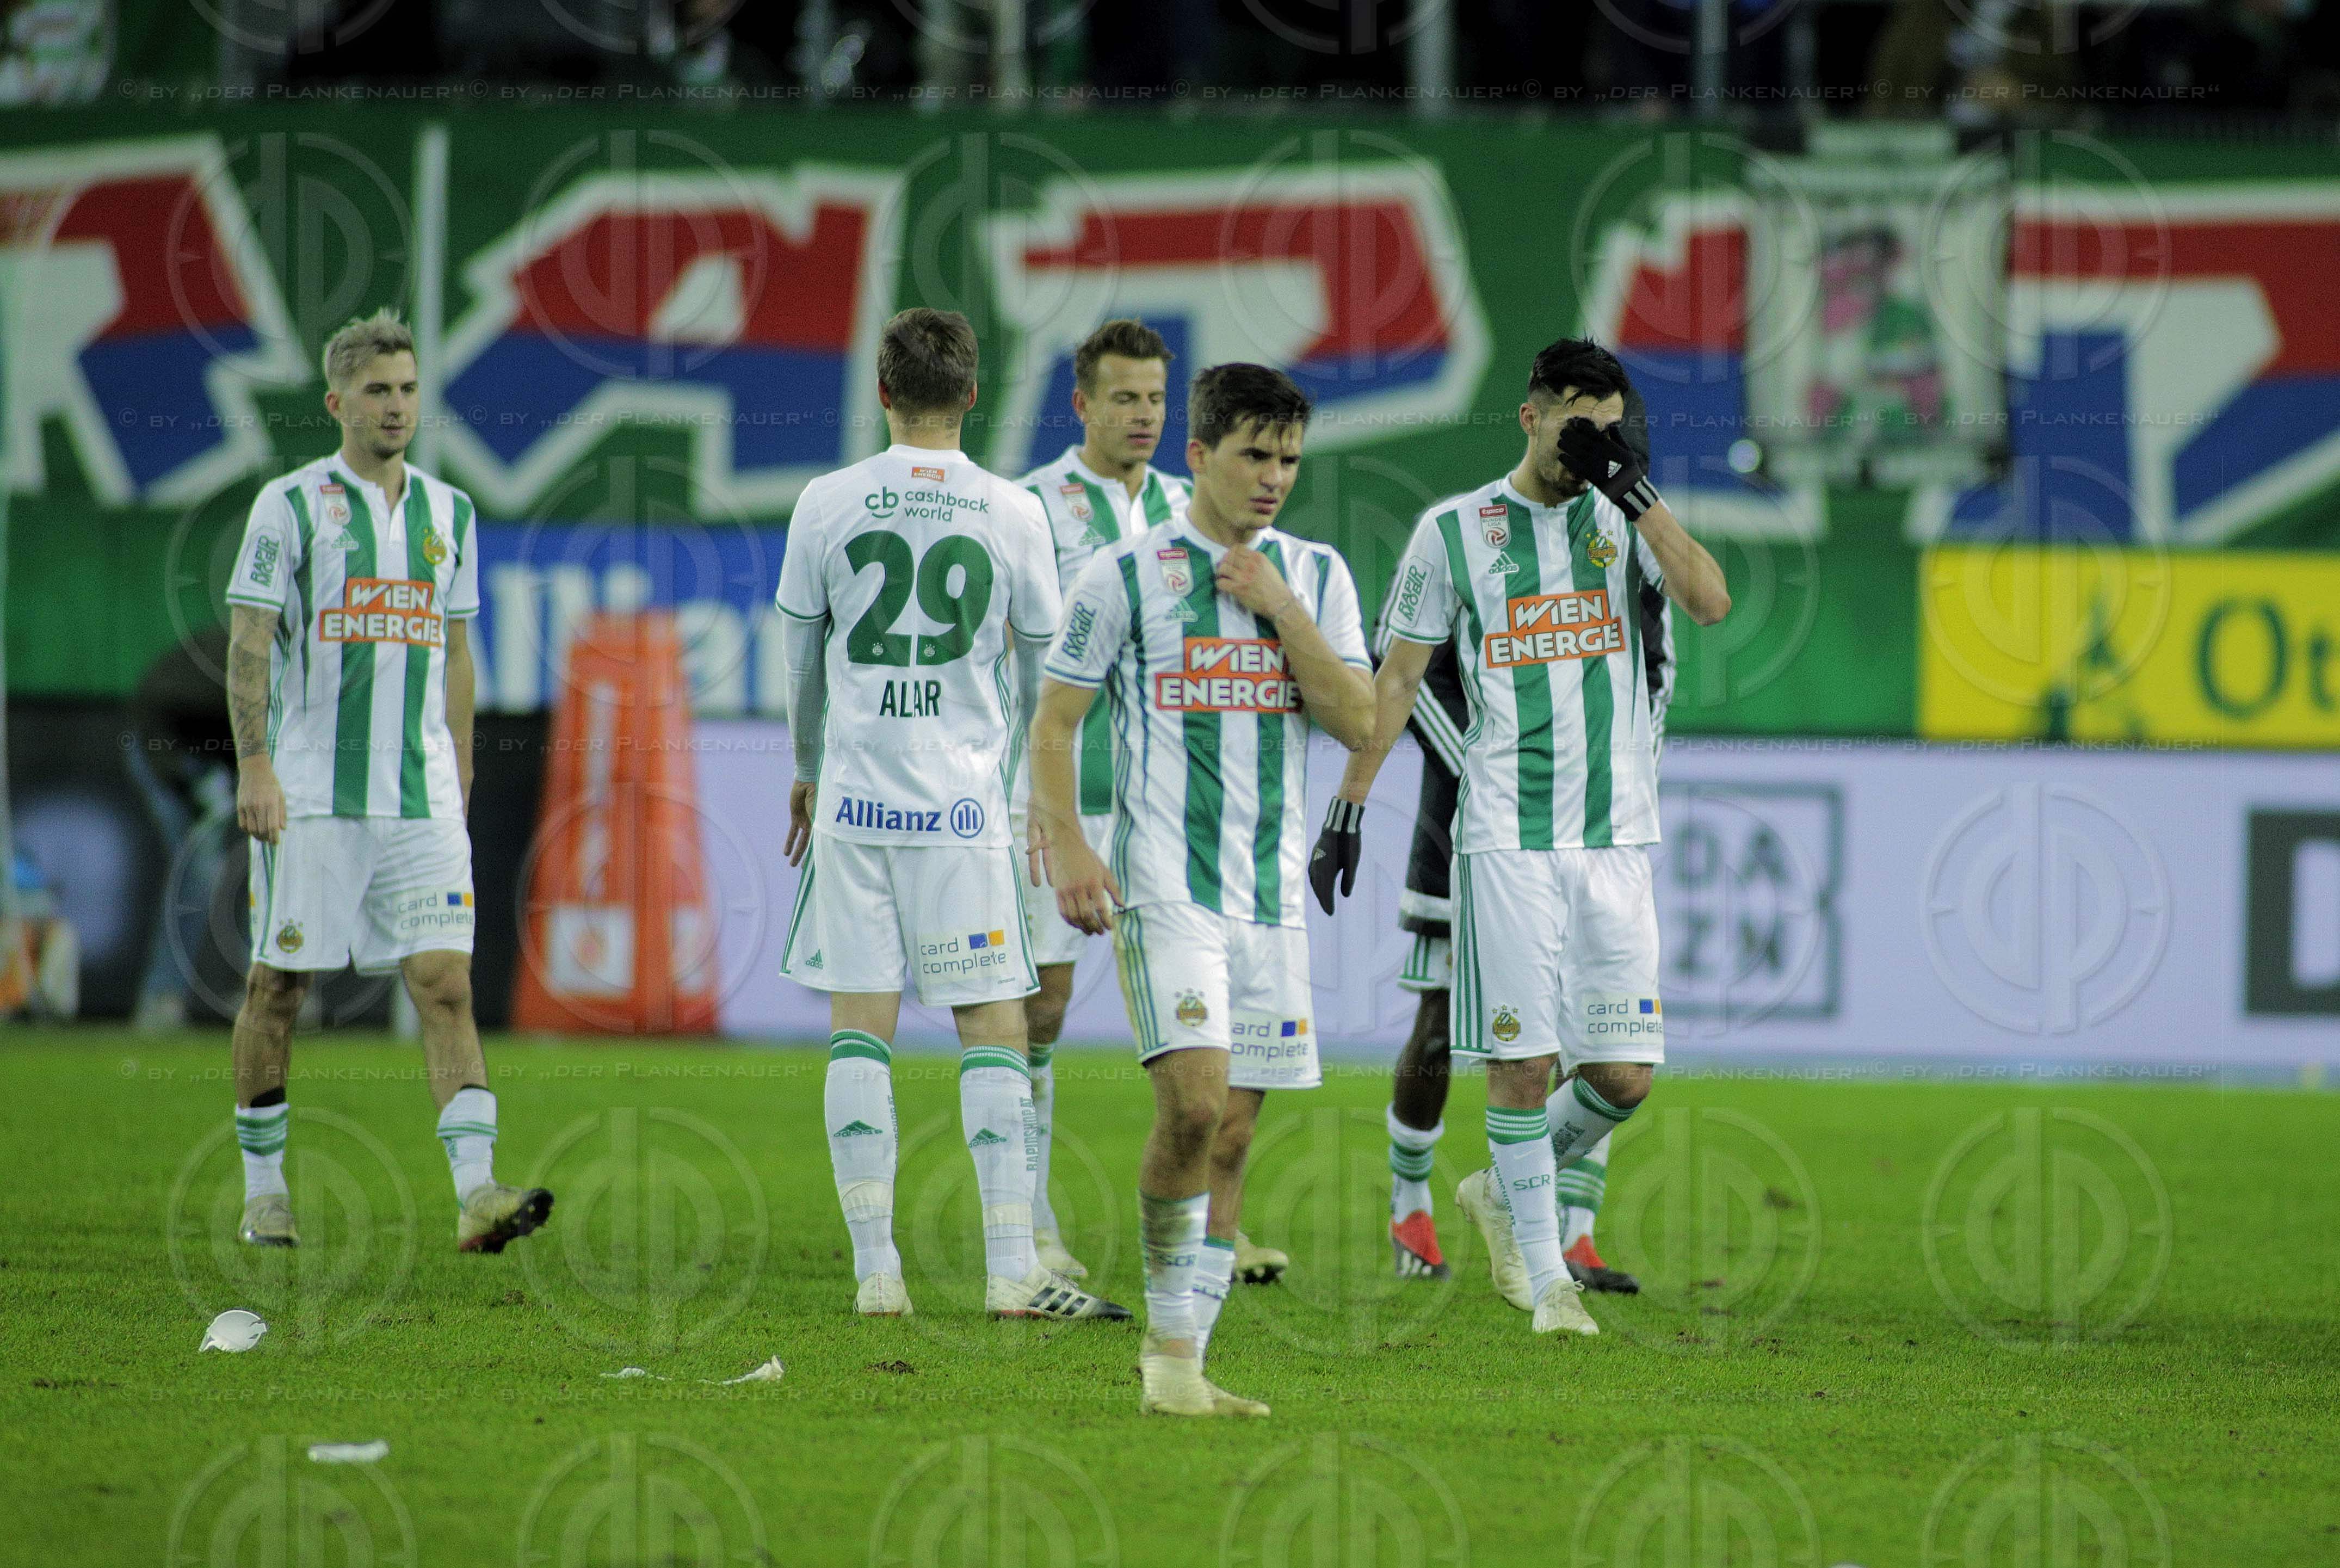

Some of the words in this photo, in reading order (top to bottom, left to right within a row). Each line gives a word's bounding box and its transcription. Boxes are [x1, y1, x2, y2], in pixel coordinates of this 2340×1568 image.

[904, 507, 953, 522] world
[905, 490, 990, 513] cashback
[350, 583, 429, 611] WIEN
[844, 529, 994, 668] 29
[1514, 596, 1605, 631] WIEN
[323, 613, 441, 643] ENERGIE
[1490, 621, 1622, 664] ENERGIE
[1189, 643, 1283, 674] WIEN
[879, 680, 942, 718] ALAR
[1160, 677, 1302, 709] ENERGIE
[835, 796, 942, 832] Allianz
[398, 892, 438, 913] card
[919, 936, 959, 956] card
[922, 950, 1007, 975] complete
[1587, 998, 1628, 1015] card
[1231, 1021, 1271, 1038] ard
[1231, 1041, 1308, 1063] omplete
[1513, 1174, 1551, 1190] SCR
